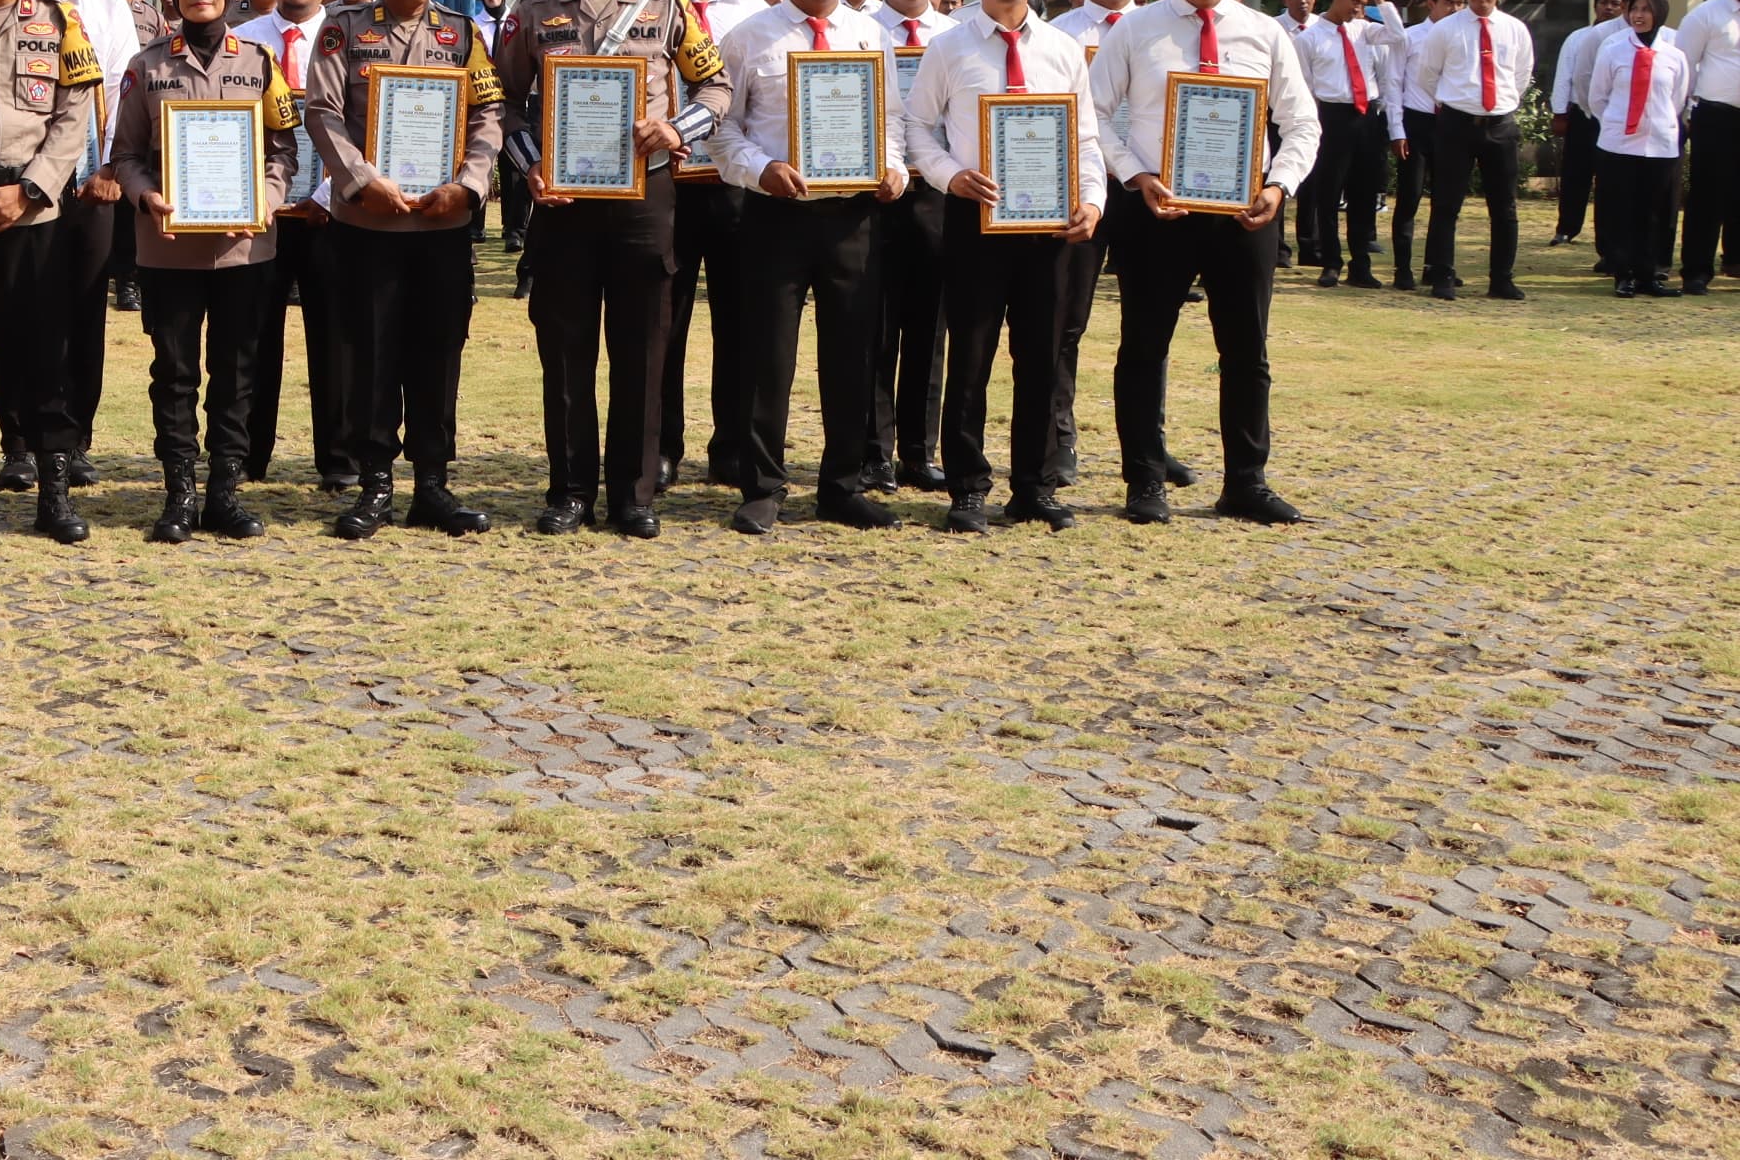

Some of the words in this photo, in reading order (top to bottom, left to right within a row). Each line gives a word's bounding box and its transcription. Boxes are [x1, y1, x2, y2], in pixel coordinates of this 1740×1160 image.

[629, 25, 661, 39] OLRI
[17, 40, 60, 54] POLRI
[425, 49, 465, 65] POLRI
[148, 78, 184, 92] AINAL
[222, 75, 262, 89] POLRI
